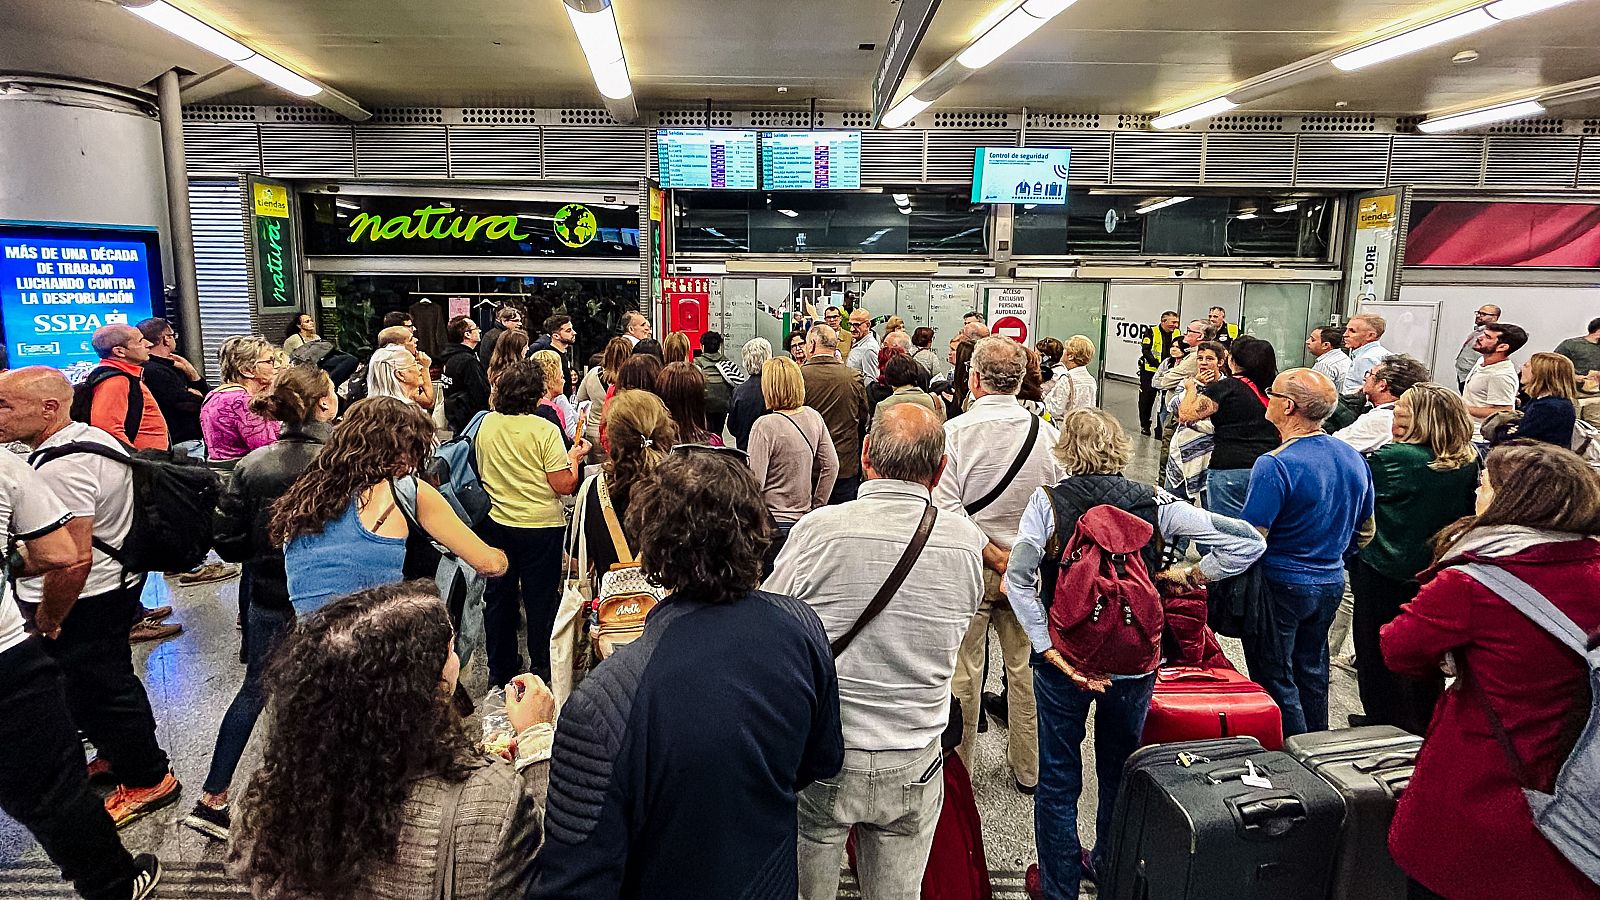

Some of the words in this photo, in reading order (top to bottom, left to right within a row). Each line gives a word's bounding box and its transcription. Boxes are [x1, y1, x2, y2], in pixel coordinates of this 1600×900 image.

[258, 200, 286, 208] tiendas
[347, 205, 530, 242] natura
[5, 244, 38, 258] MÁS
[41, 248, 59, 260] DE
[61, 248, 88, 260] UNA
[91, 247, 138, 261] DÉCADA
[267, 220, 287, 302] natura
[37, 263, 54, 274] DE
[57, 263, 114, 275] TRABAJO
[1364, 246, 1376, 284] STORE
[16, 277, 84, 290] LUCHANDO
[88, 278, 136, 290] CONTRA
[21, 292, 39, 304] LA
[42, 290, 134, 304] DESPOBLACIÓN
[34, 314, 102, 332] SSPA
[1116, 322, 1156, 339] STOR
